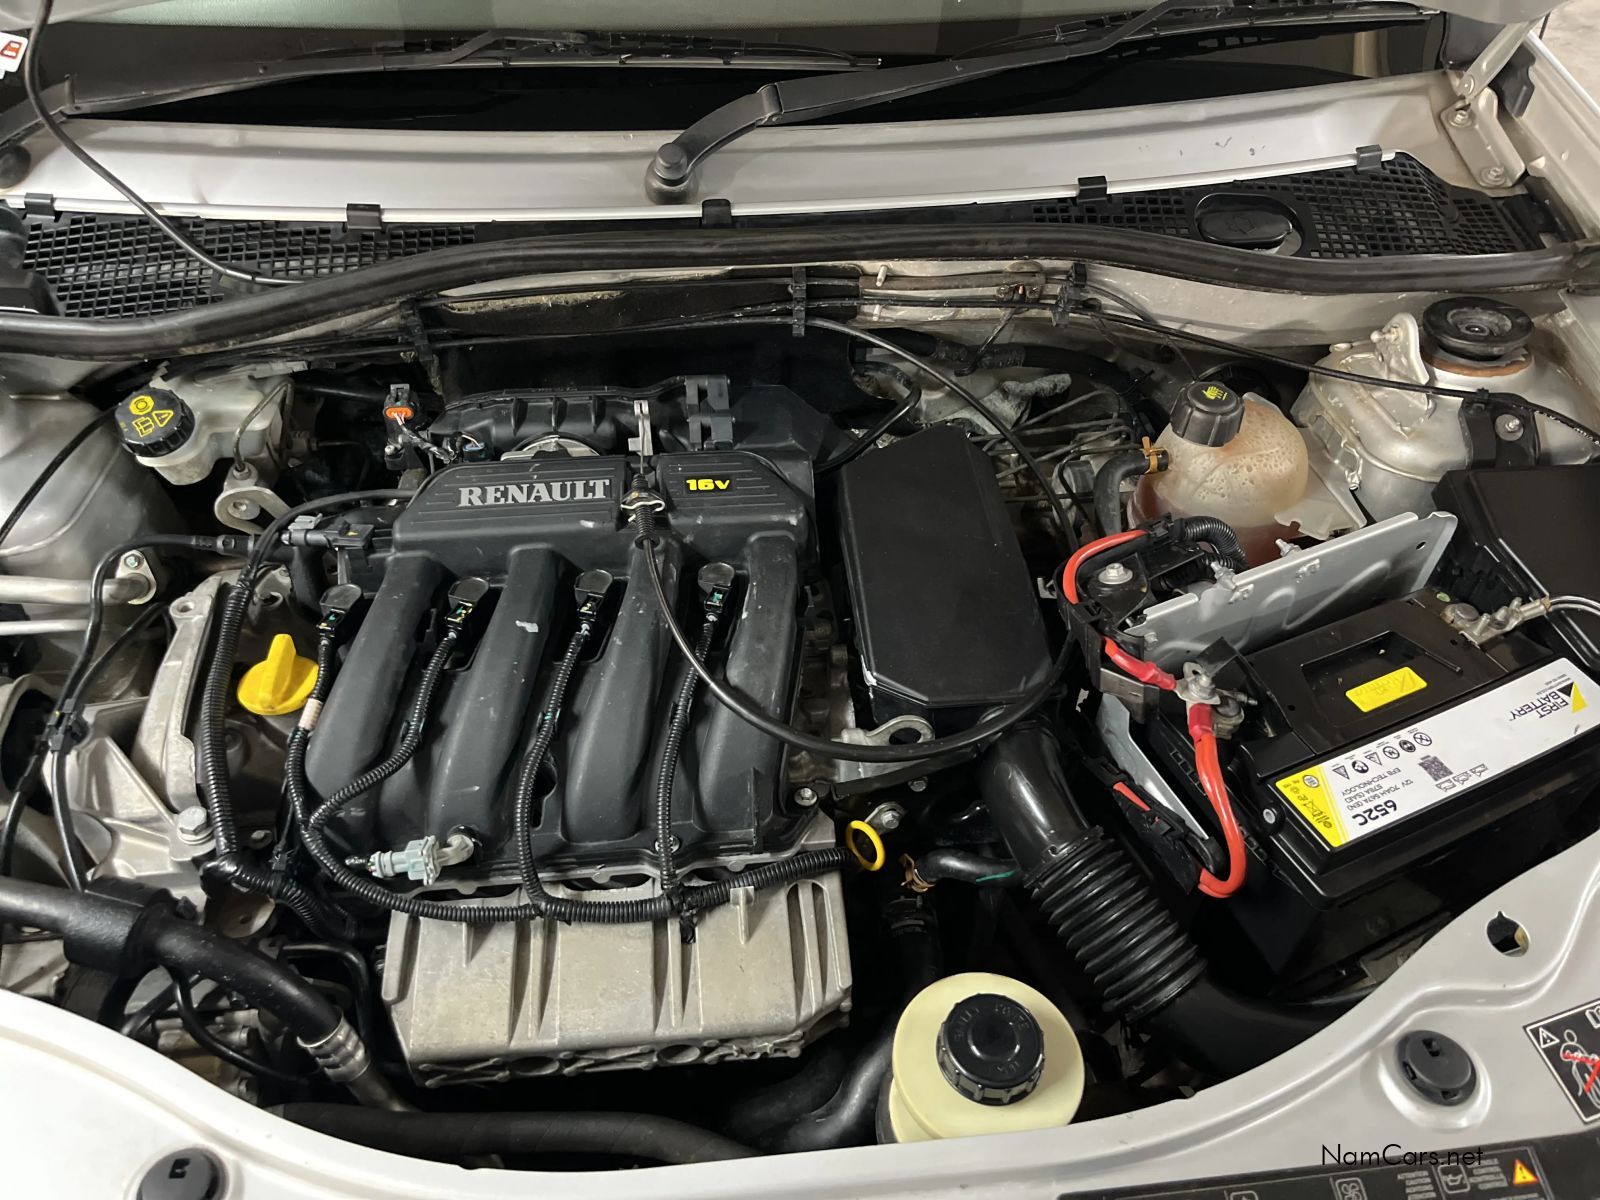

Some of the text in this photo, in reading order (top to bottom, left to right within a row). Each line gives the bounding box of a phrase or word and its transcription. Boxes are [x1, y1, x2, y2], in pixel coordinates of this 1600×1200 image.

[459, 479, 611, 507] RENAULT
[1510, 690, 1560, 719] BATTERY
[1534, 698, 1568, 718] FIRST
[1341, 773, 1388, 796] TECHNOLOGY
[1352, 799, 1397, 827] 652C
